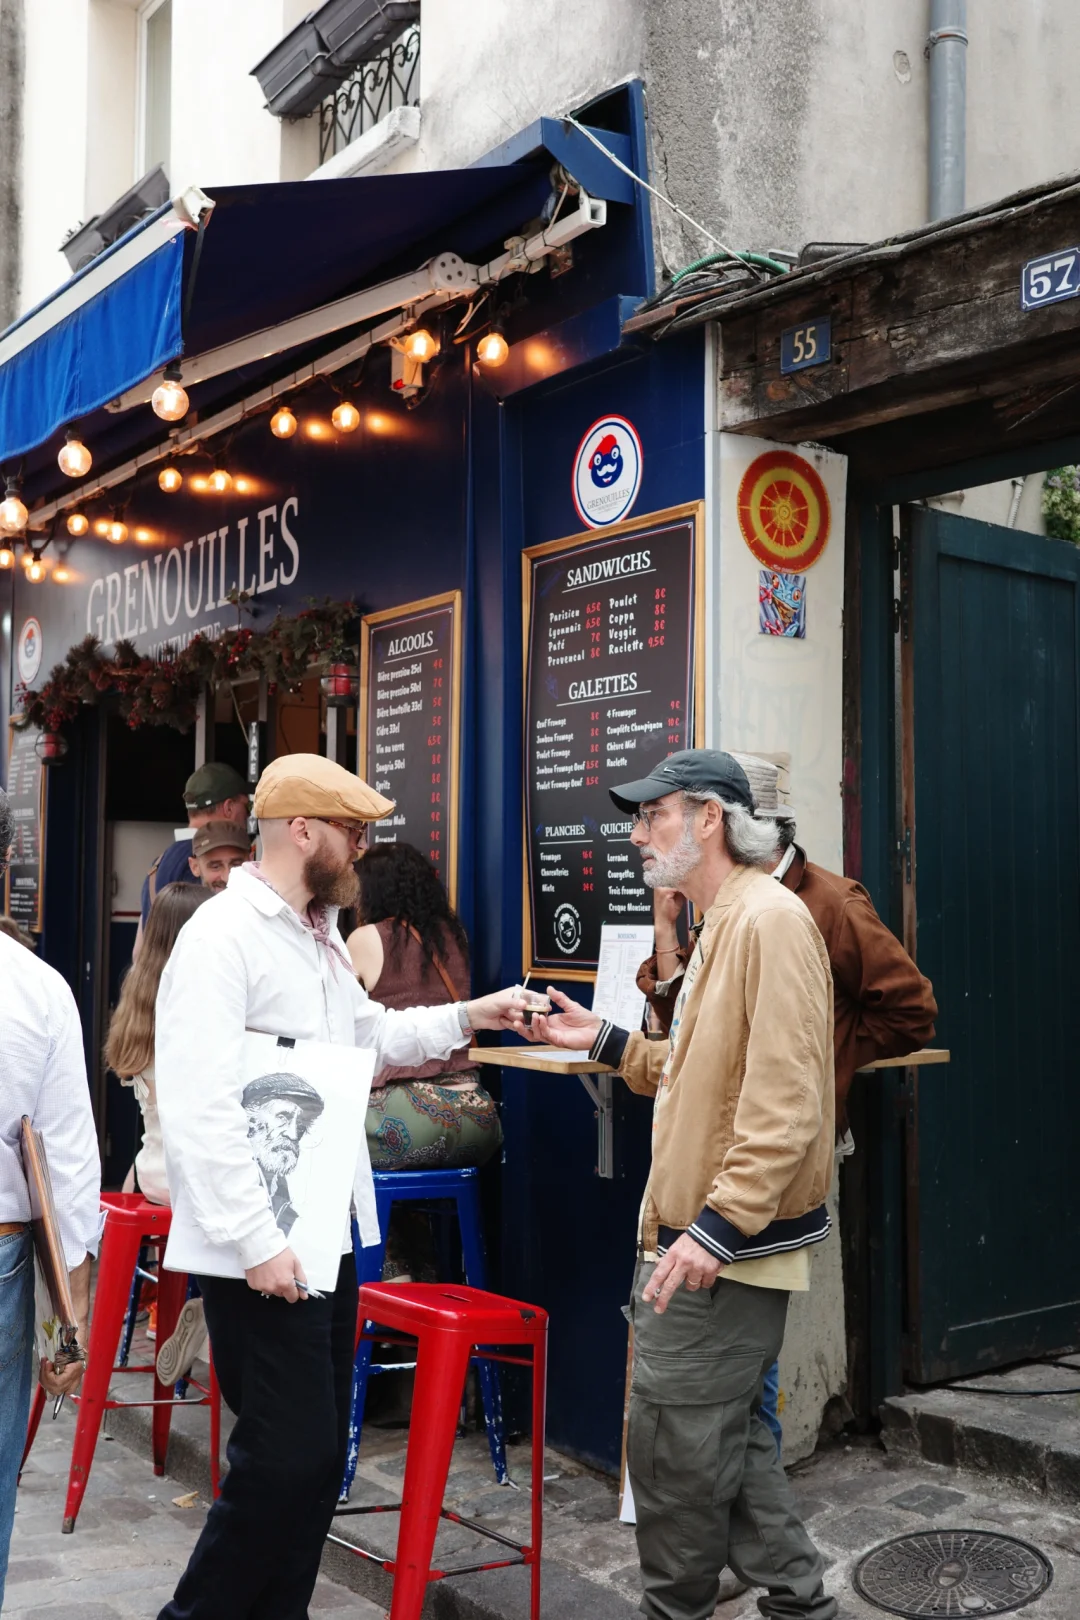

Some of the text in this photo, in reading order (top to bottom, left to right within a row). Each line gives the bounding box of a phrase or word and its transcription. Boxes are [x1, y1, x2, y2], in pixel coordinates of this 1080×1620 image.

[1030, 255, 1076, 297] 57
[792, 326, 816, 363] 55
[587, 488, 629, 509] GRENOUILLES
[87, 497, 299, 646] GRENOUILLES
[567, 551, 650, 586] SANDWICHS
[609, 594, 637, 609] Poulet
[550, 610, 579, 623] Parisien
[609, 612, 634, 625] Coppa
[549, 623, 581, 639] Lyonnais
[609, 626, 636, 640] Veggie
[388, 630, 433, 656] ALCOOLS
[548, 639, 565, 652] Paté
[609, 640, 643, 655] Raclette
[568, 672, 638, 700] GALETTES
[612, 709, 636, 718] Fromages
[607, 757, 627, 767] Raclette
[376, 780, 391, 792] Spritz
[545, 824, 585, 837] PLANCHES
[600, 822, 635, 836] QUICHE
[607, 854, 628, 862] Lorraine
[608, 869, 634, 880] Courgettes
[608, 886, 620, 895] Trois
[609, 903, 651, 914] Croque Monsieur
